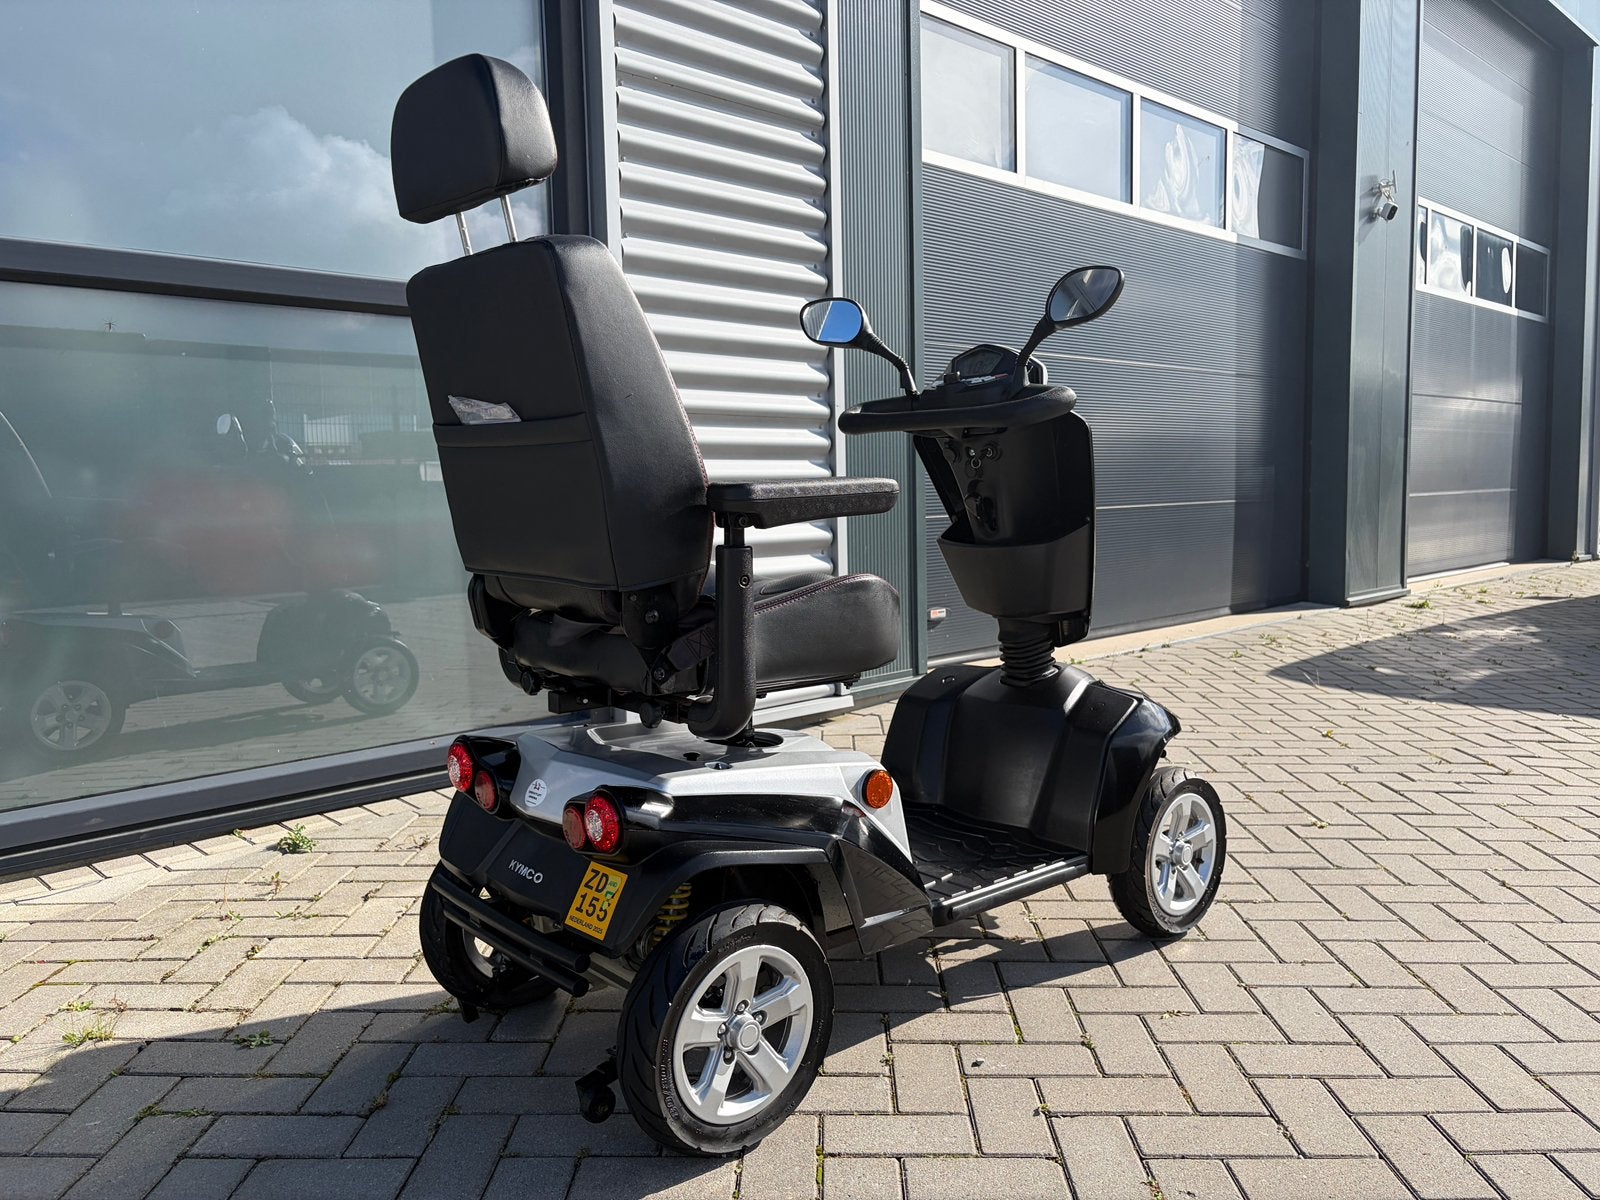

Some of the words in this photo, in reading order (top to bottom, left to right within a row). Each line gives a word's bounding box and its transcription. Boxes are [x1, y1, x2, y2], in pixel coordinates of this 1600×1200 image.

[508, 859, 543, 884] KYMCO
[575, 893, 610, 922] 155
[570, 915, 593, 930] NEDERLAND
